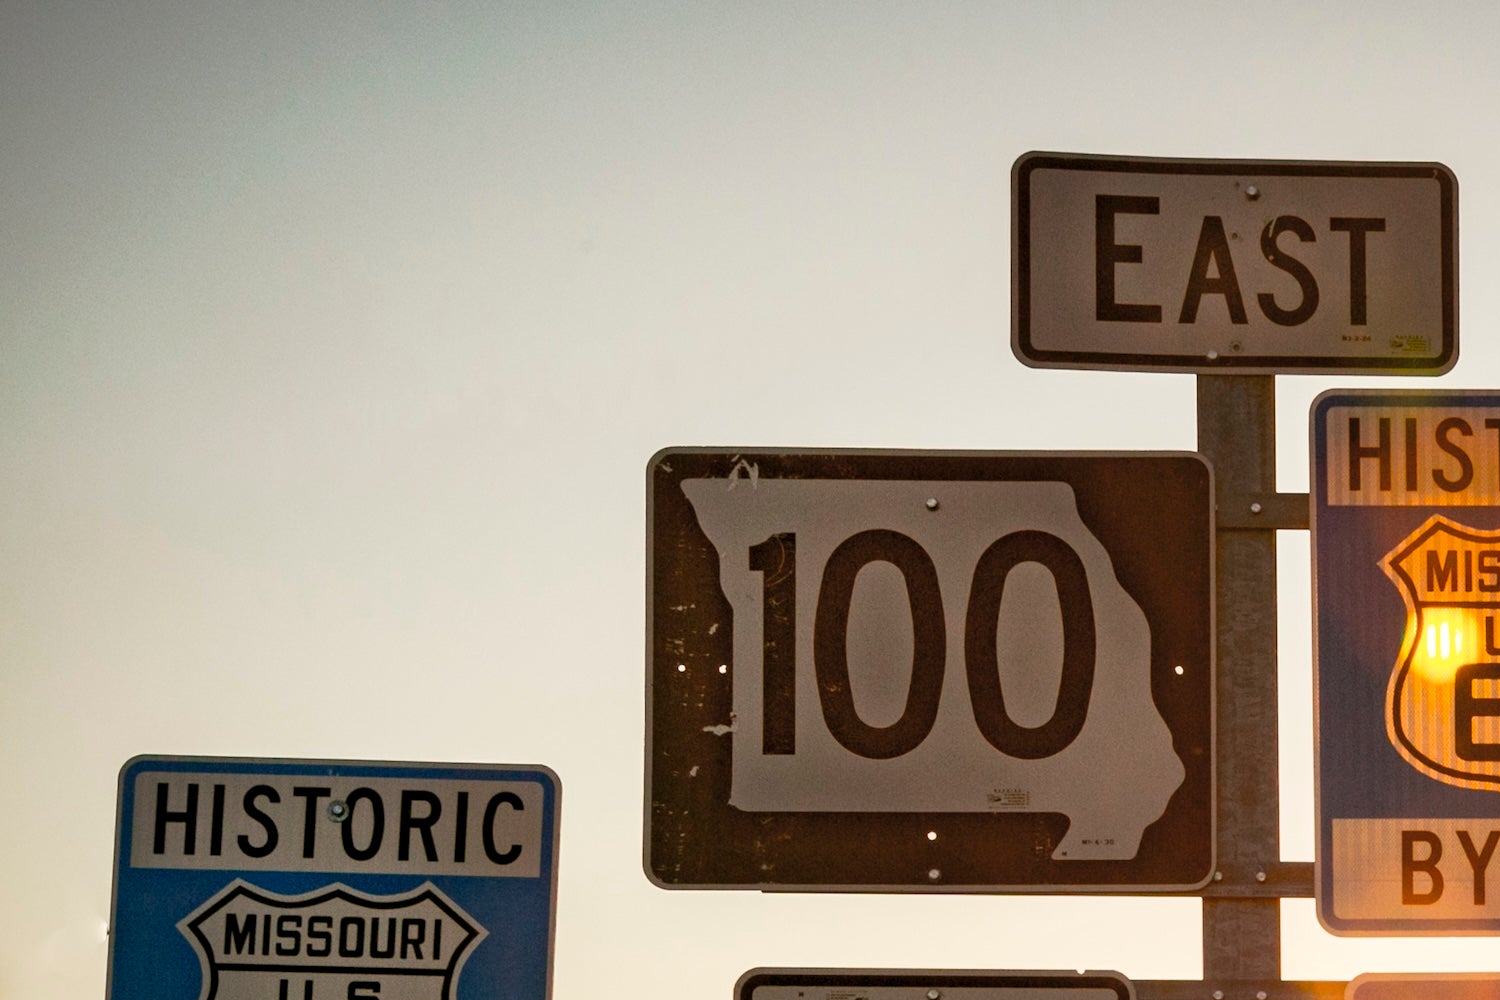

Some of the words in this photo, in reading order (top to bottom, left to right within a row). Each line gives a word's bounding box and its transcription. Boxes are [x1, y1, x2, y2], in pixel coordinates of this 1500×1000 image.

[1095, 194, 1386, 327] EAST
[748, 529, 1097, 760] 100
[152, 782, 525, 866] HISTORIC
[223, 913, 443, 960] MISSOURI
